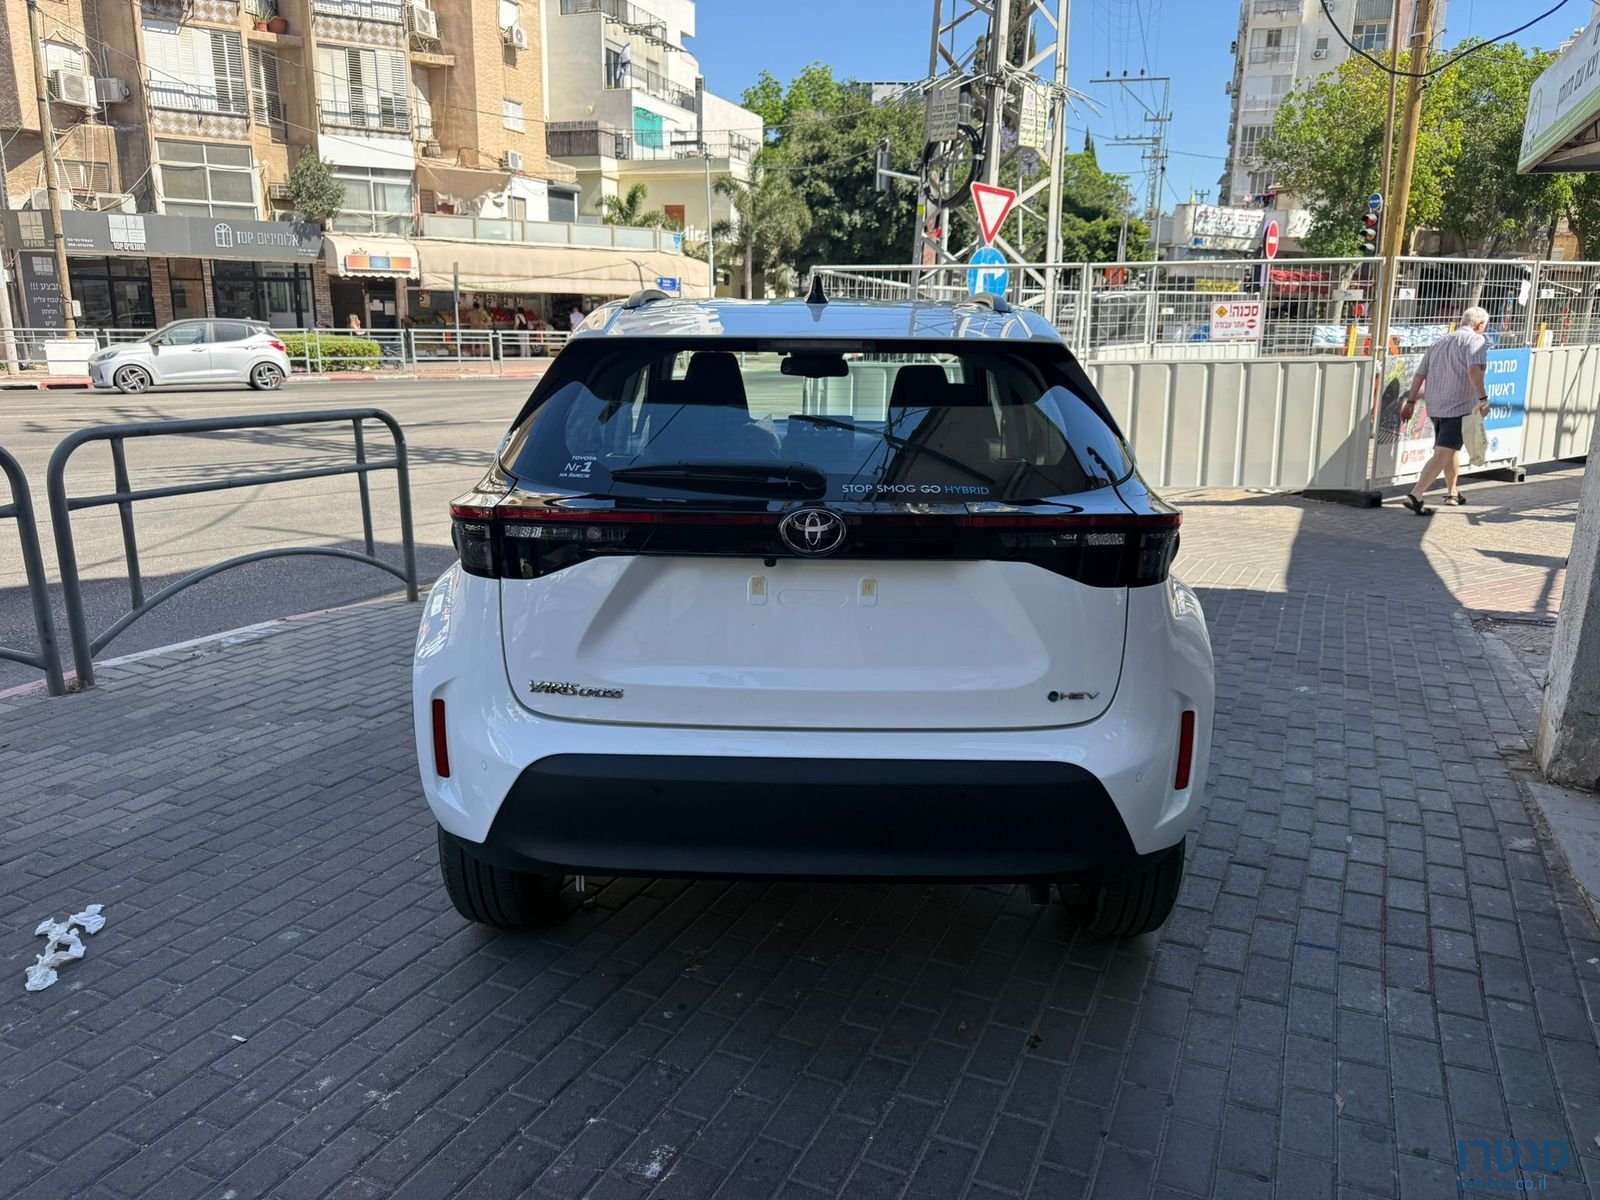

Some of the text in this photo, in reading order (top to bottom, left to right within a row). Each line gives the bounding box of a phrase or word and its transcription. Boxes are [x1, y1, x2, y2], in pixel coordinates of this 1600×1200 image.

[236, 231, 300, 247] TOP אלומיניום
[1230, 304, 1259, 317] סכנה!
[1486, 359, 1517, 374] מחברי
[1488, 381, 1515, 399] ראשון
[1485, 402, 1513, 420] למטר
[842, 484, 990, 495] STOP SMOG GO HYBRID
